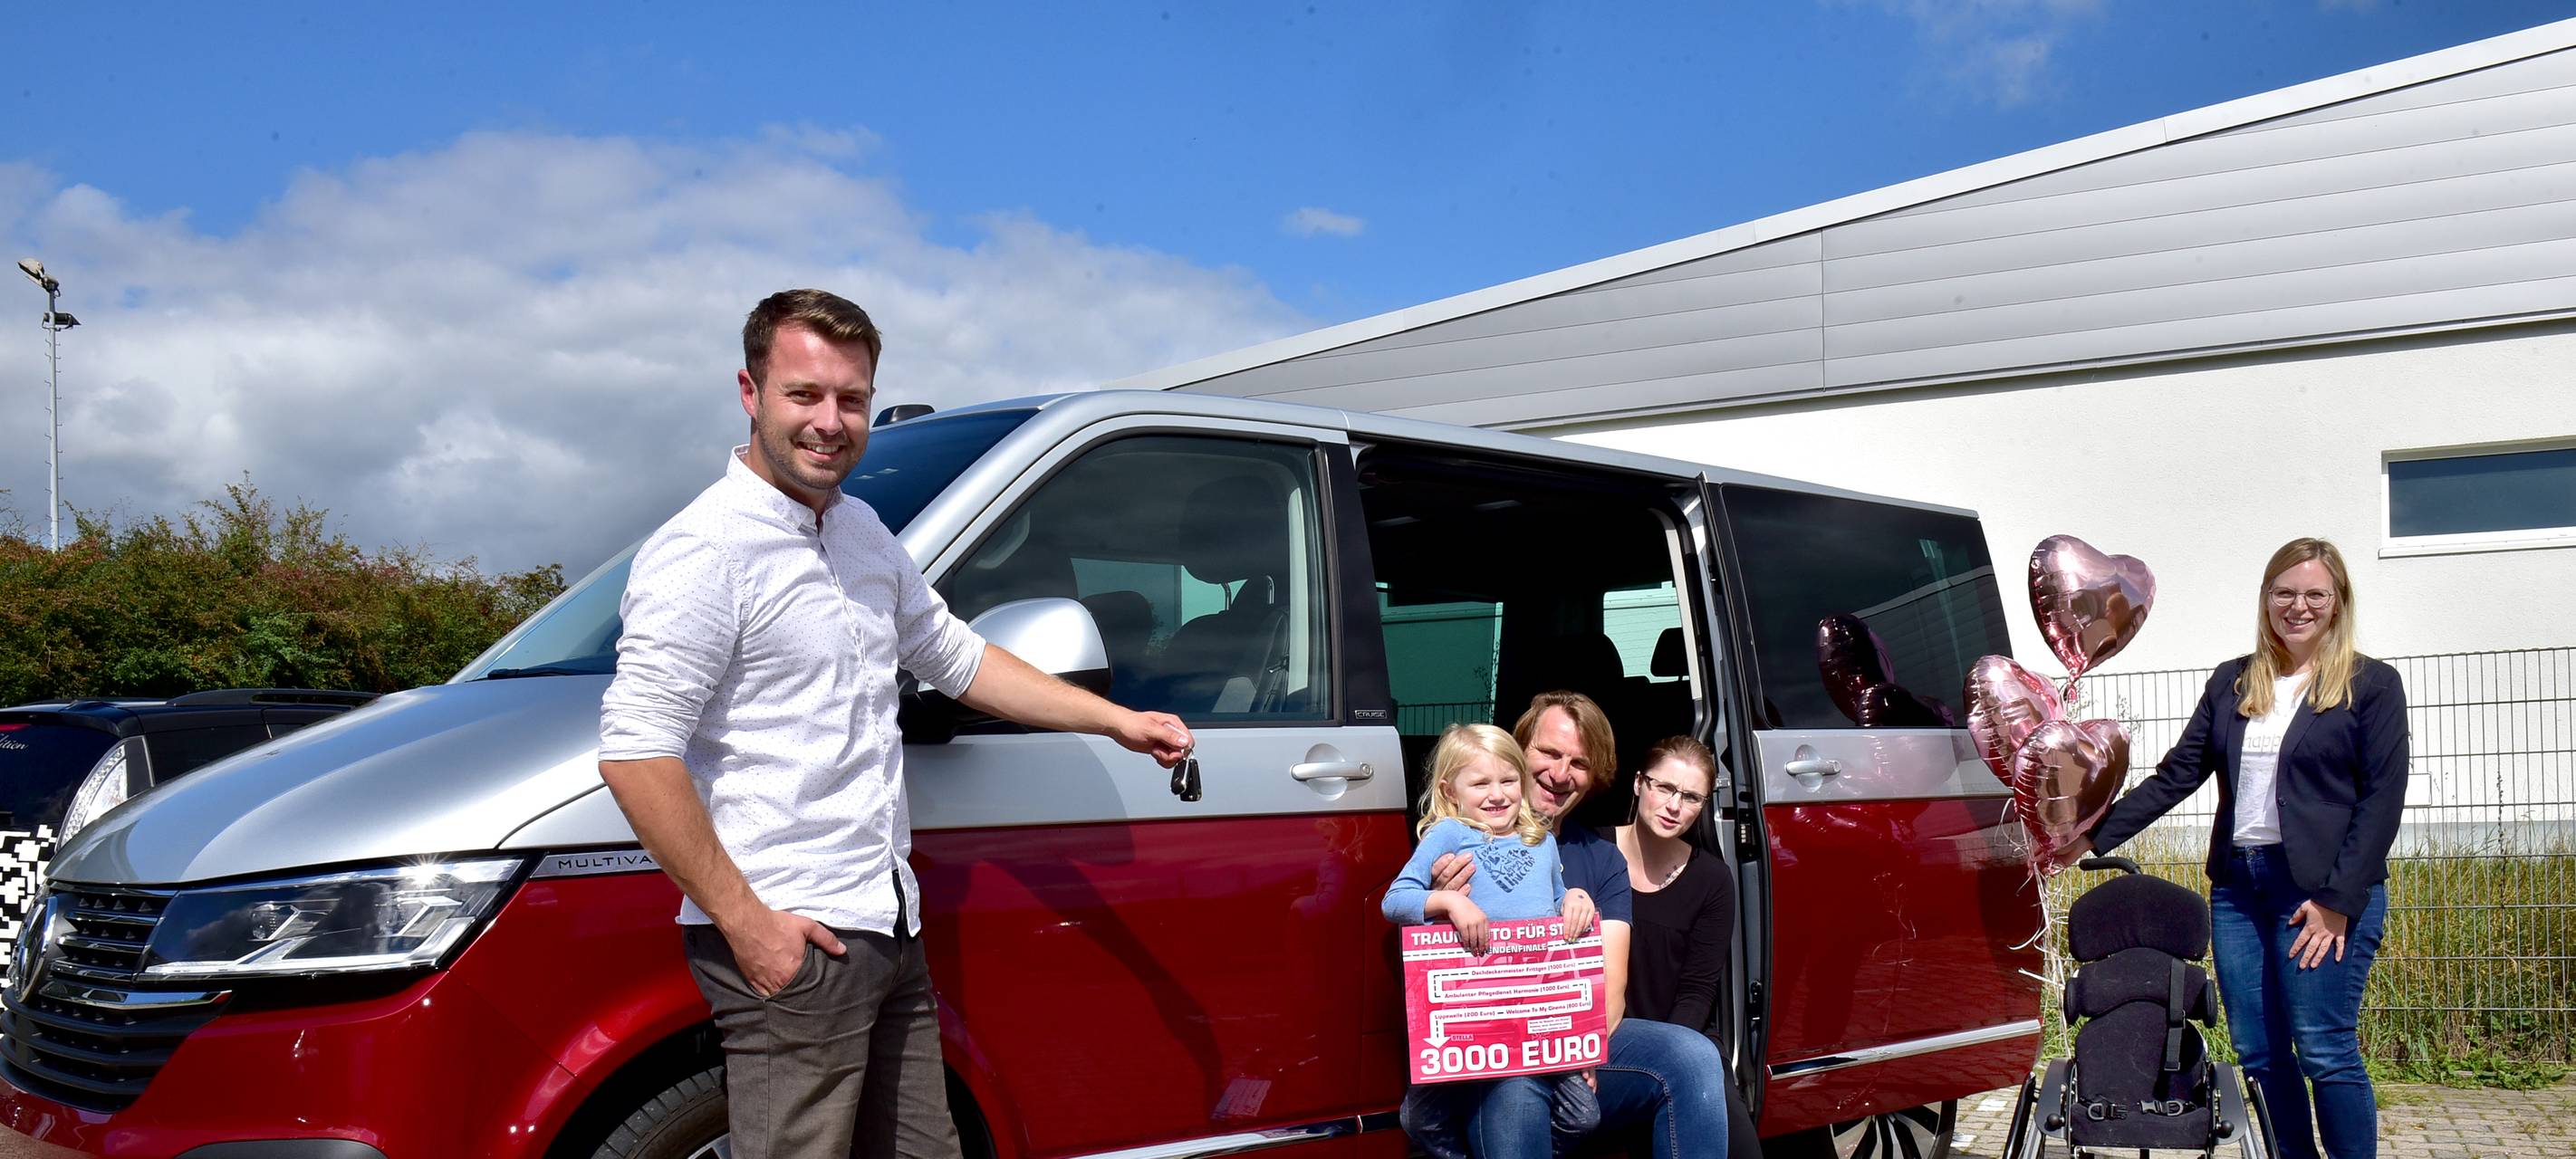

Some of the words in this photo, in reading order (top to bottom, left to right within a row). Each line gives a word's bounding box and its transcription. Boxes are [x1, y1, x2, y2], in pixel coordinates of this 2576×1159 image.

[558, 855, 653, 869] MULTIVA
[1516, 923, 1546, 940] FÜR
[1477, 989, 1513, 997] Pflegedienst
[1505, 1007, 1531, 1015] Welcome
[1548, 1003, 1566, 1011] Cinema
[1420, 1043, 1509, 1075] 3000
[1522, 1033, 1600, 1067] EURO
